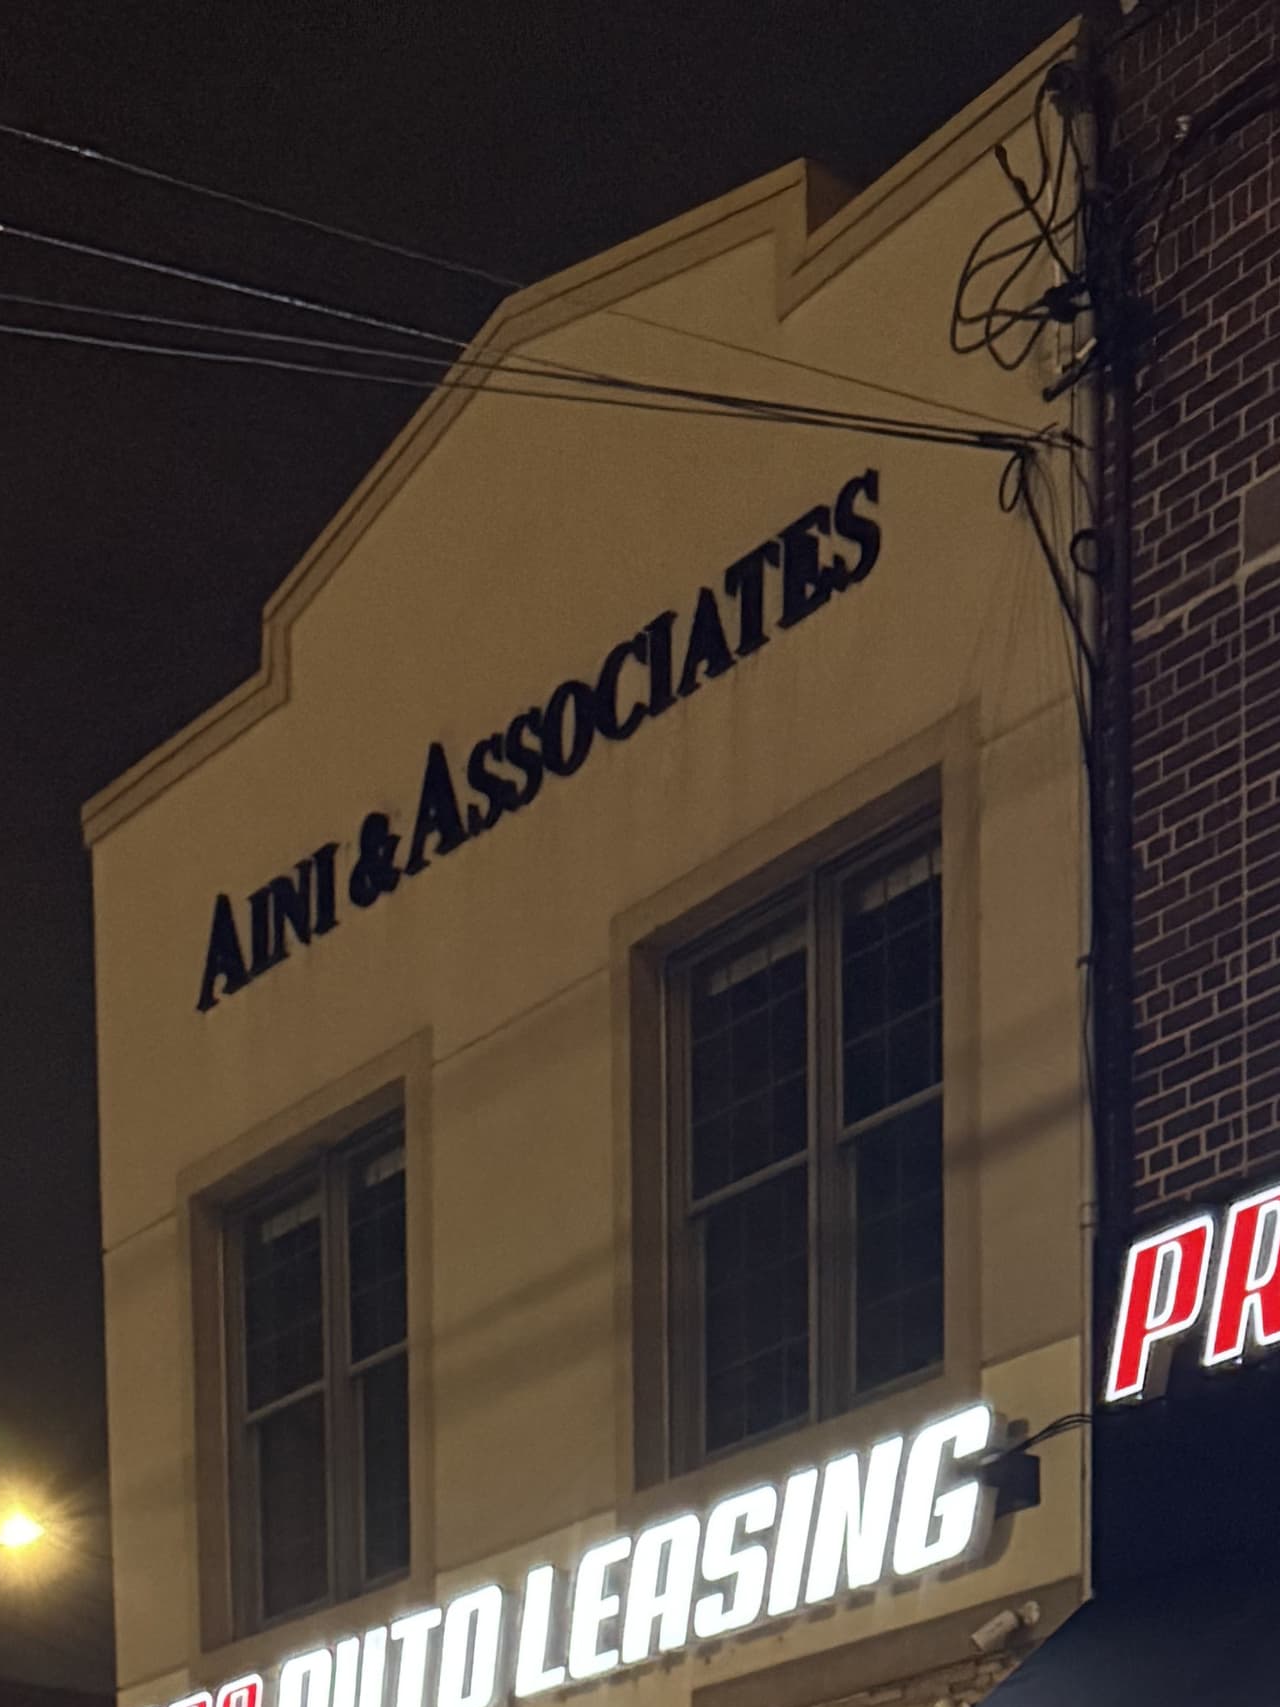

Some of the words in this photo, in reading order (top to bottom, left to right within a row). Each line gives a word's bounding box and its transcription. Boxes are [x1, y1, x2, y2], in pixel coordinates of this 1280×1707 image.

[196, 843, 340, 1014] AINI
[349, 813, 401, 908] &
[404, 469, 882, 876] ASSOCIATES
[514, 1403, 996, 1700] LEASING
